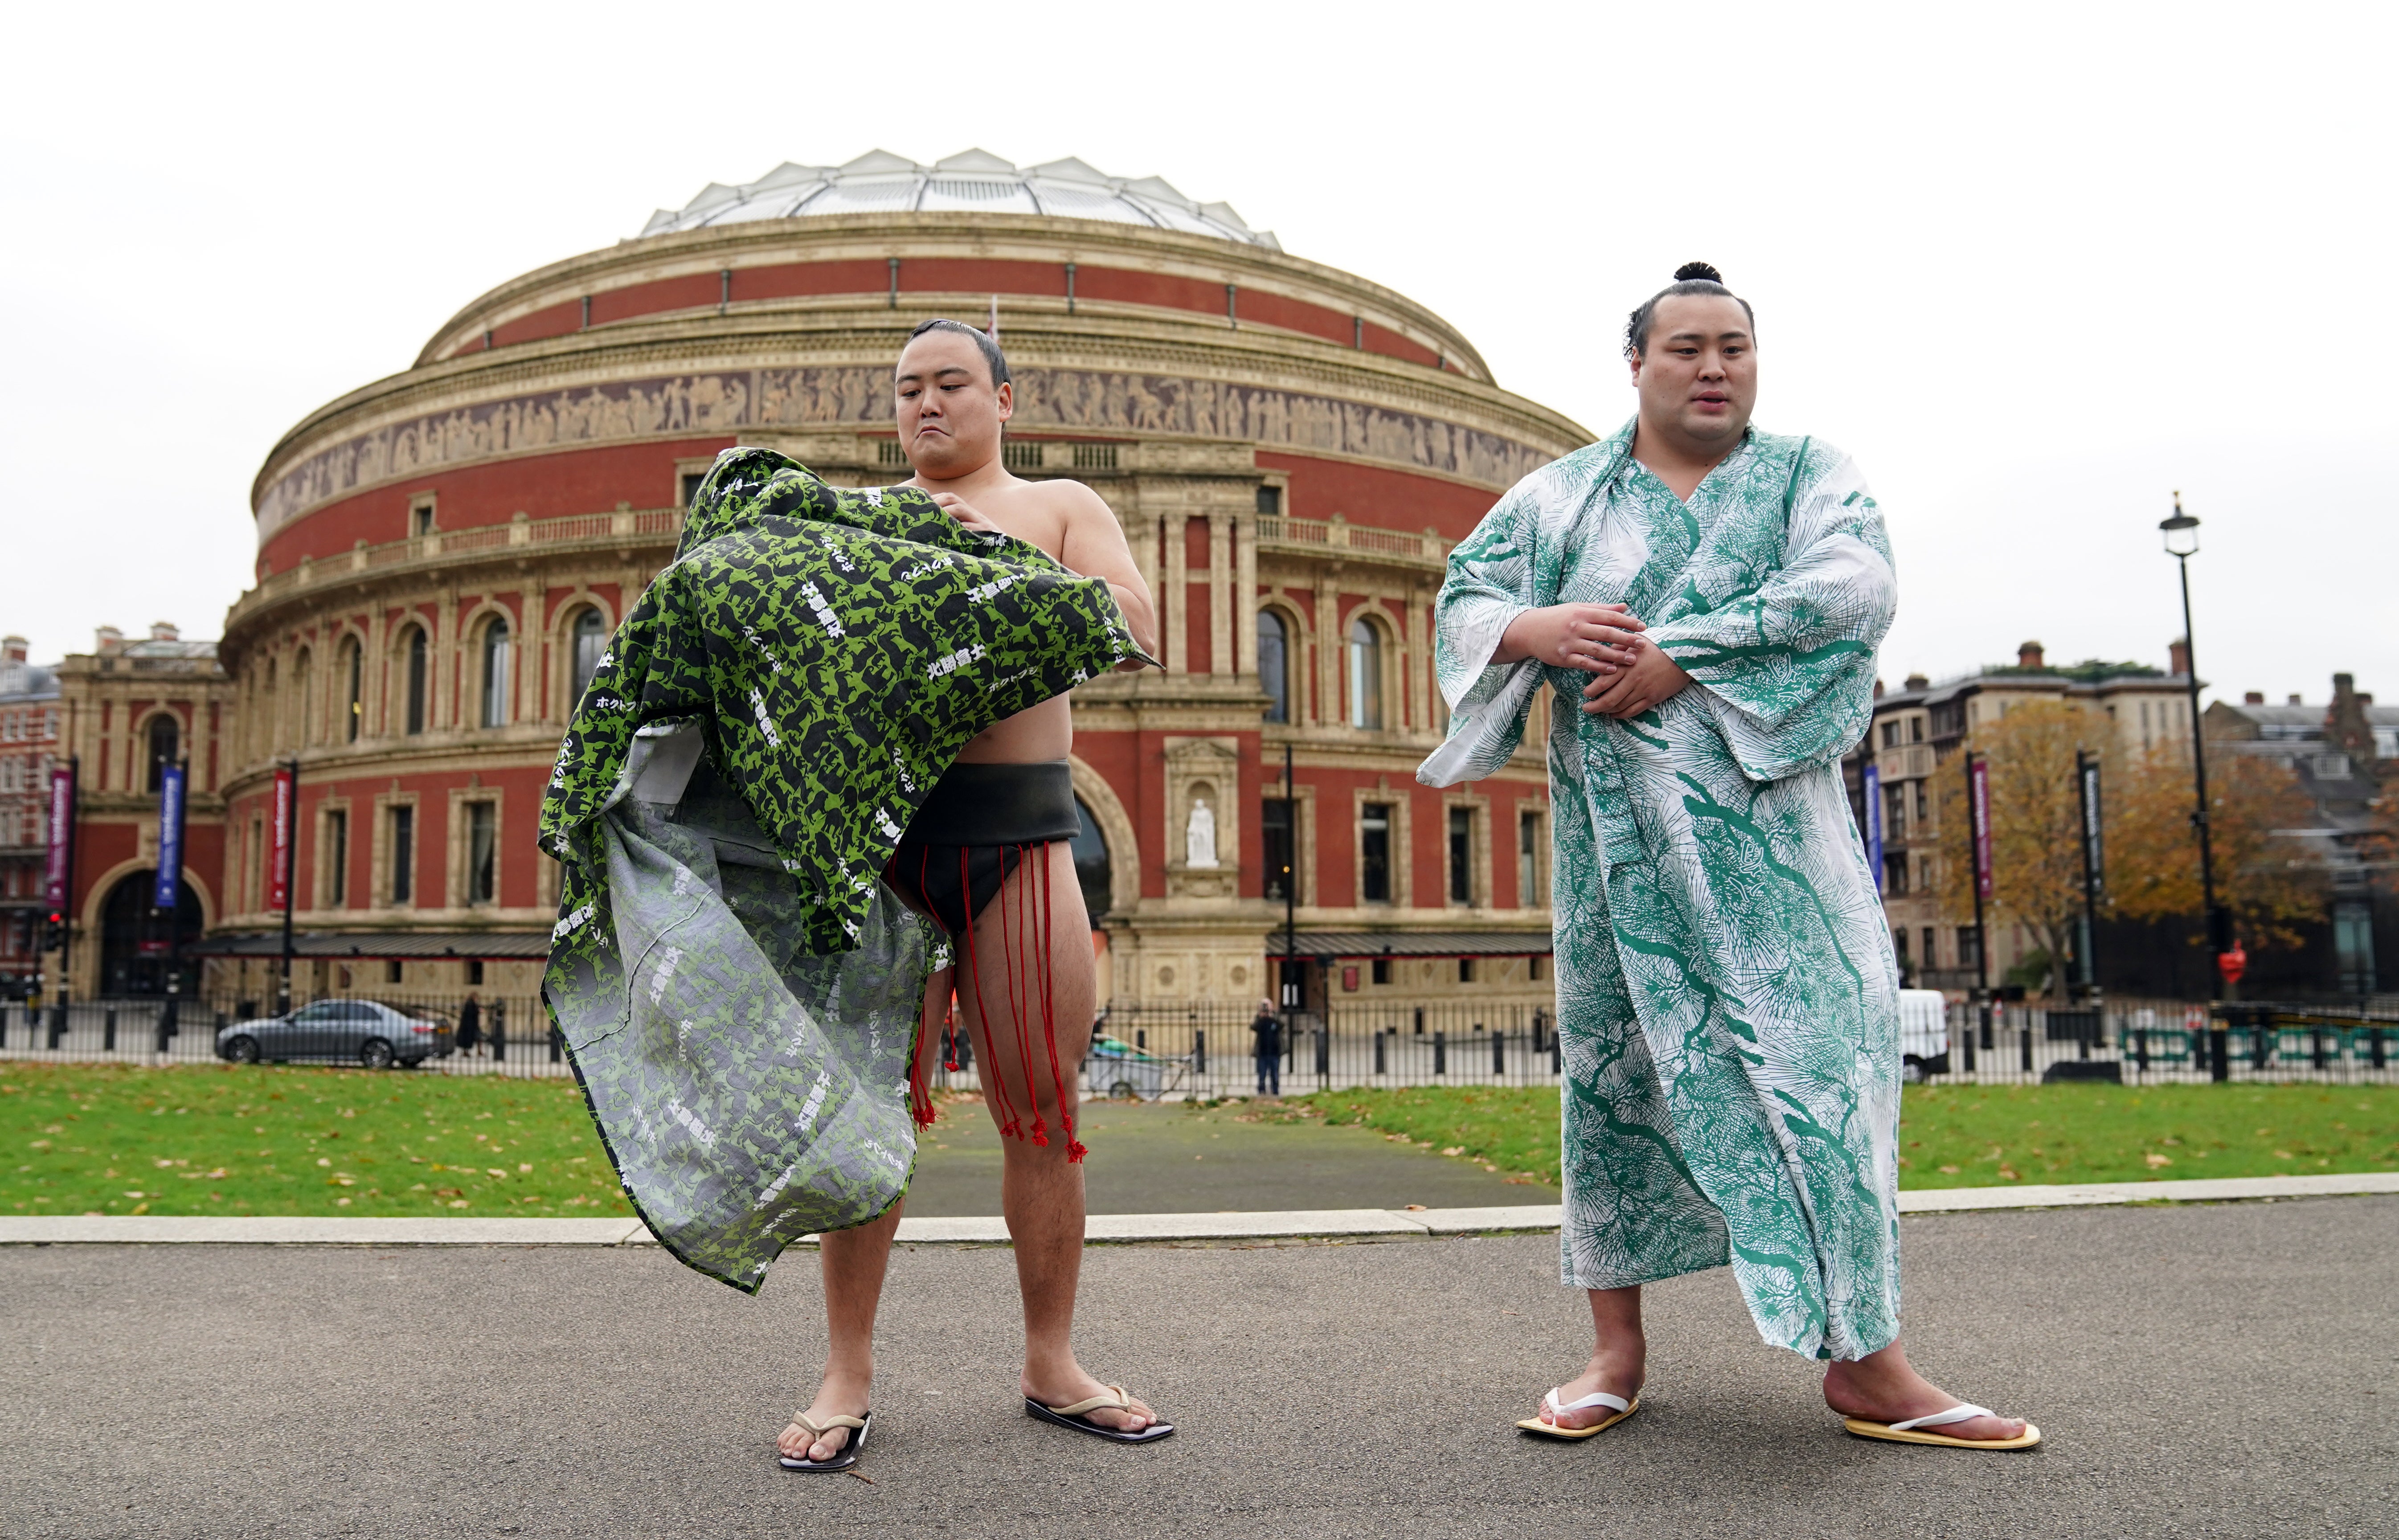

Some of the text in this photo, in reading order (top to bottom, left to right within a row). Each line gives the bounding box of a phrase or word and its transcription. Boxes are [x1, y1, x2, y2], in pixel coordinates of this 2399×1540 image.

[819, 536, 855, 573] ホクトフジ
[901, 557, 954, 582] ホクトフジ
[802, 581, 846, 639] 北勝富士
[741, 626, 782, 674] ホクトフジ
[926, 643, 987, 680] 北勝富士
[989, 665, 1038, 692] ホクトフジ
[596, 696, 638, 713] ホクトフ
[750, 686, 782, 748] 北勝富士
[552, 737, 573, 789] ホクトフジ
[892, 748, 915, 793] ホクトフジ
[837, 857, 875, 900] ホクトフジ
